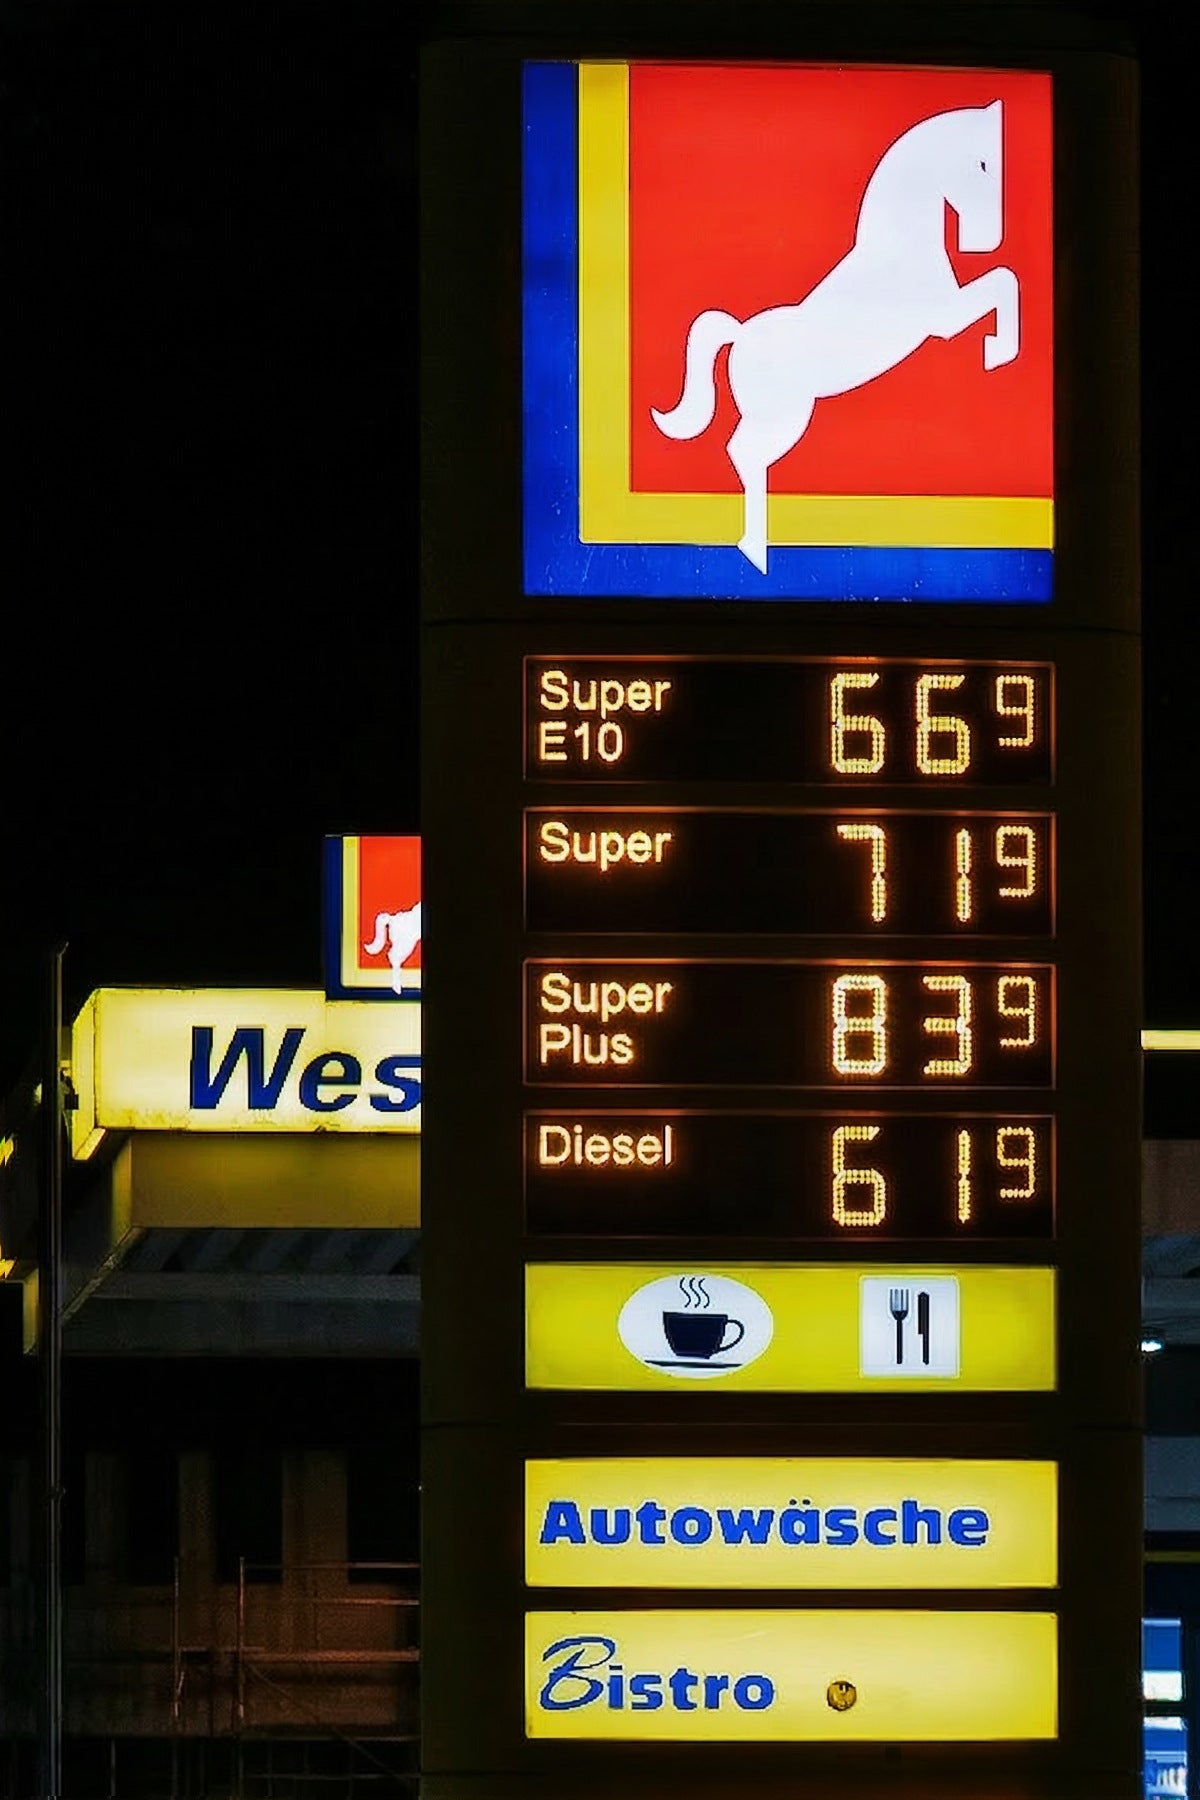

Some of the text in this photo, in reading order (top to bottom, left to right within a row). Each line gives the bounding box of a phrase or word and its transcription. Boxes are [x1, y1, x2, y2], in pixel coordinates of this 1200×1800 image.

[539, 670, 672, 718] Super
[539, 721, 623, 762] E10
[539, 821, 673, 871] Super
[539, 972, 673, 1021] Super
[539, 1022, 635, 1065] Plus
[539, 1124, 673, 1166] Diesel
[539, 1499, 990, 1547] Autowäsche
[539, 1636, 776, 1711] Bistro
